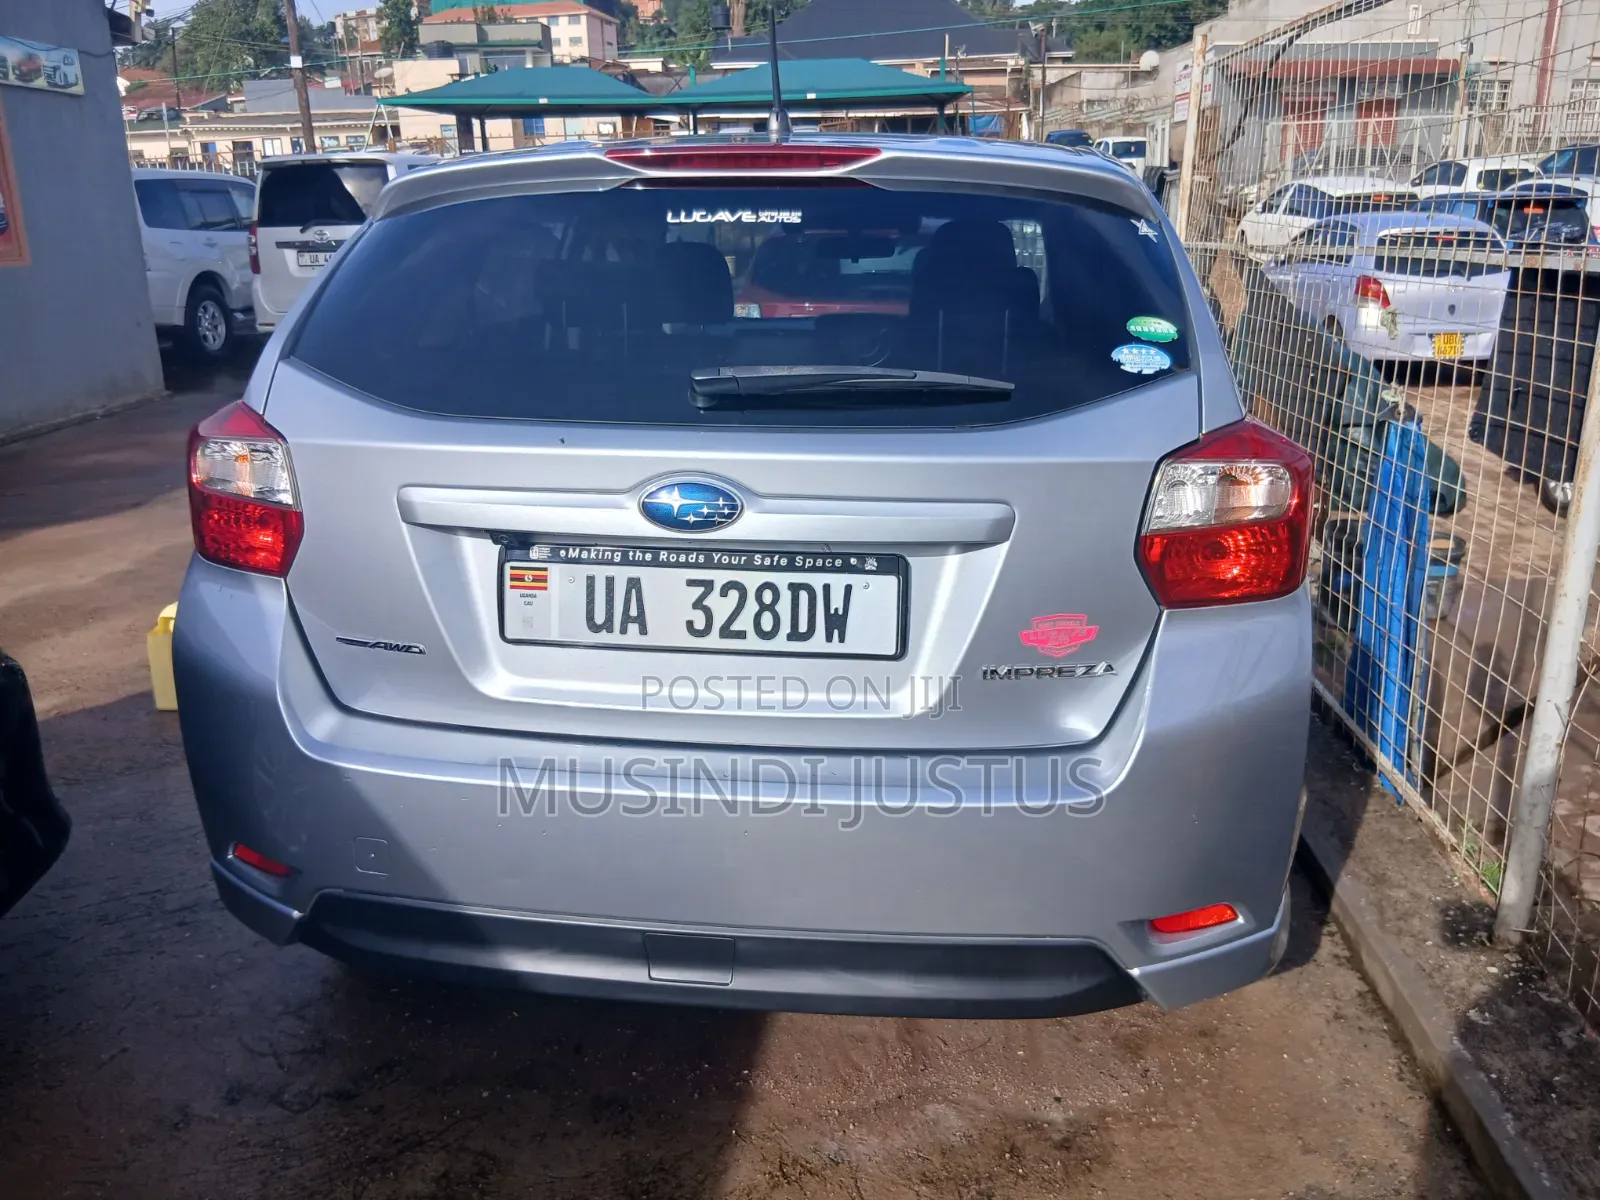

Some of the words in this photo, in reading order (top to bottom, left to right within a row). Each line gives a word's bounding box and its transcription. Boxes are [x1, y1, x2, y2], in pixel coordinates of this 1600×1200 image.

[309, 254, 320, 264] UA
[567, 547, 622, 562] Making
[628, 550, 653, 561] the
[659, 551, 705, 563] Roads
[712, 552, 748, 565] Your
[753, 554, 788, 566] Safe
[794, 556, 843, 569] Space
[585, 573, 649, 636] UA
[685, 578, 853, 644] 328DW
[368, 640, 427, 655] AWD
[981, 661, 1118, 681] IMPREZA
